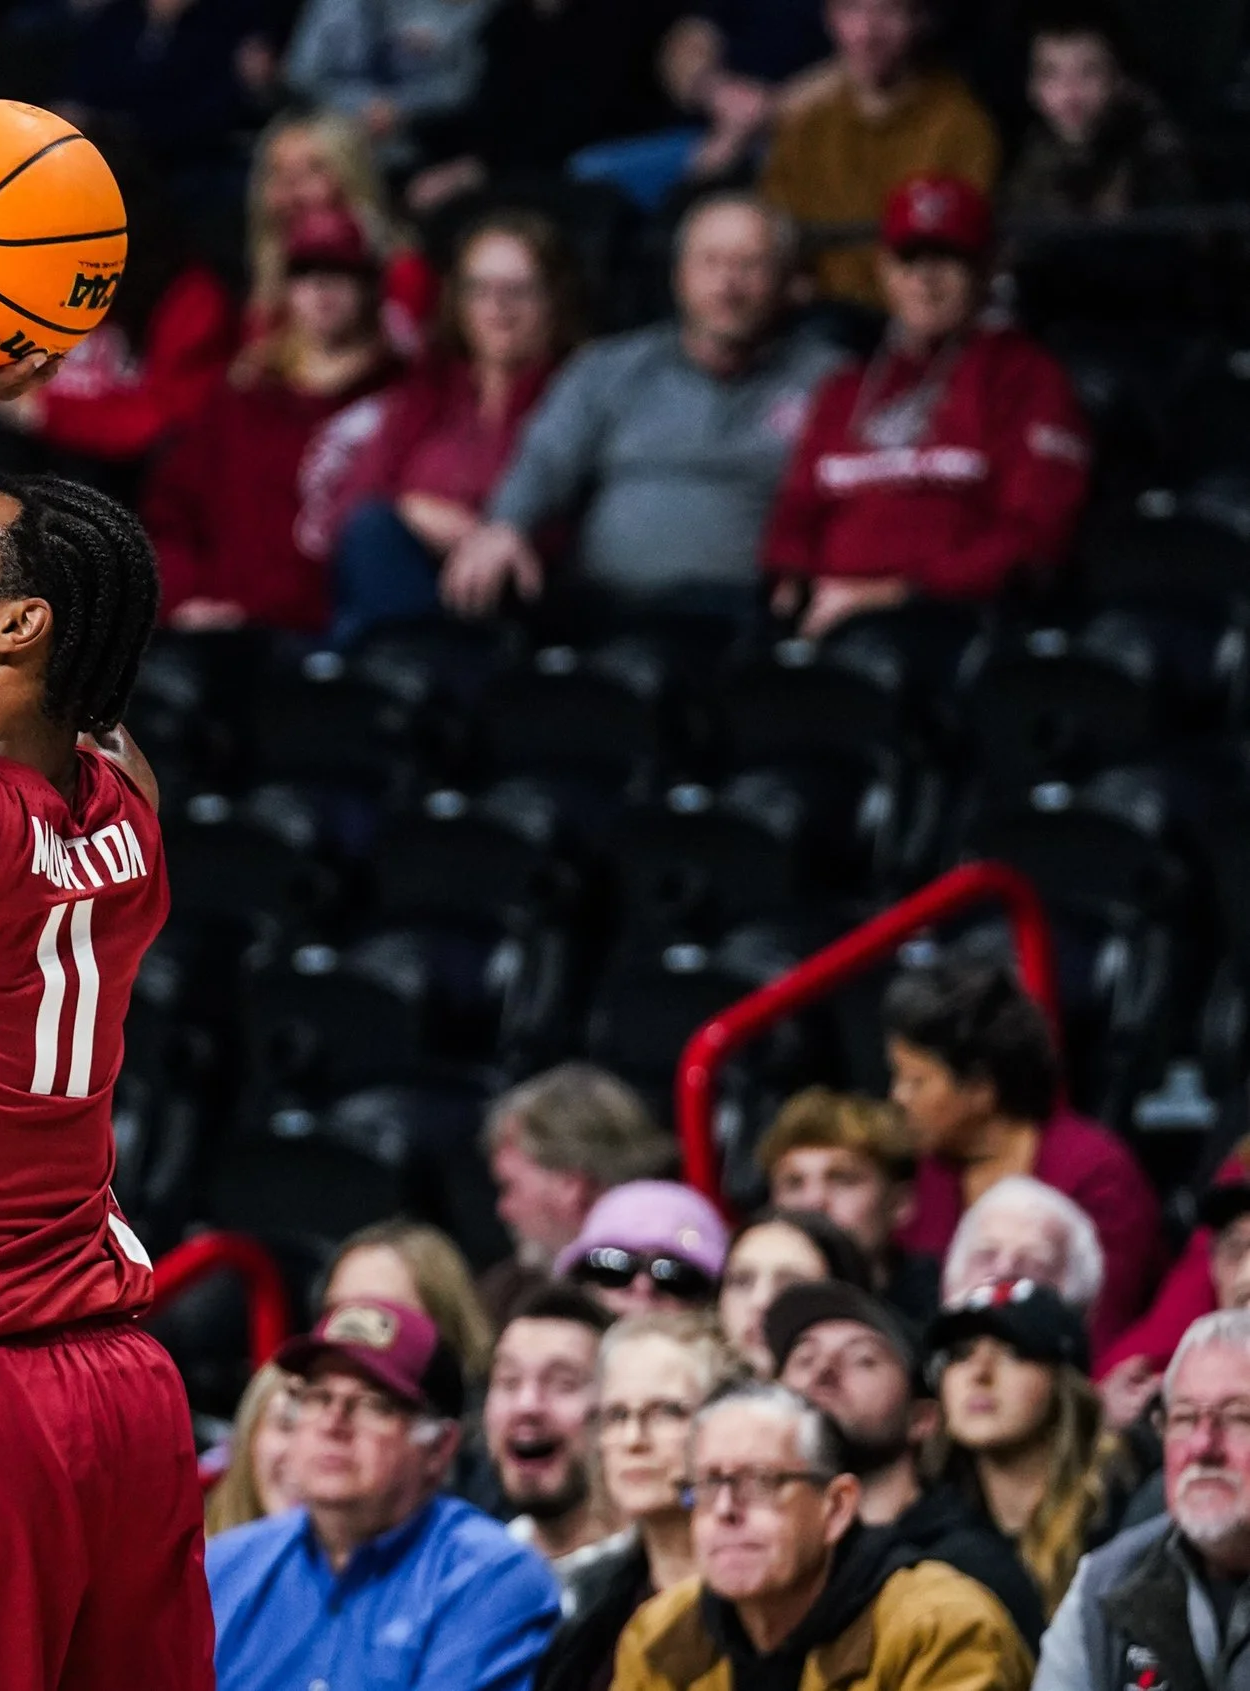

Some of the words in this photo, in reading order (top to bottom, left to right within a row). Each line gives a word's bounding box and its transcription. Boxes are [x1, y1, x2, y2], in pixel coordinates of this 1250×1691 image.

[67, 272, 121, 310] CAA
[31, 815, 147, 890] MORTON
[30, 897, 100, 1097] 11
